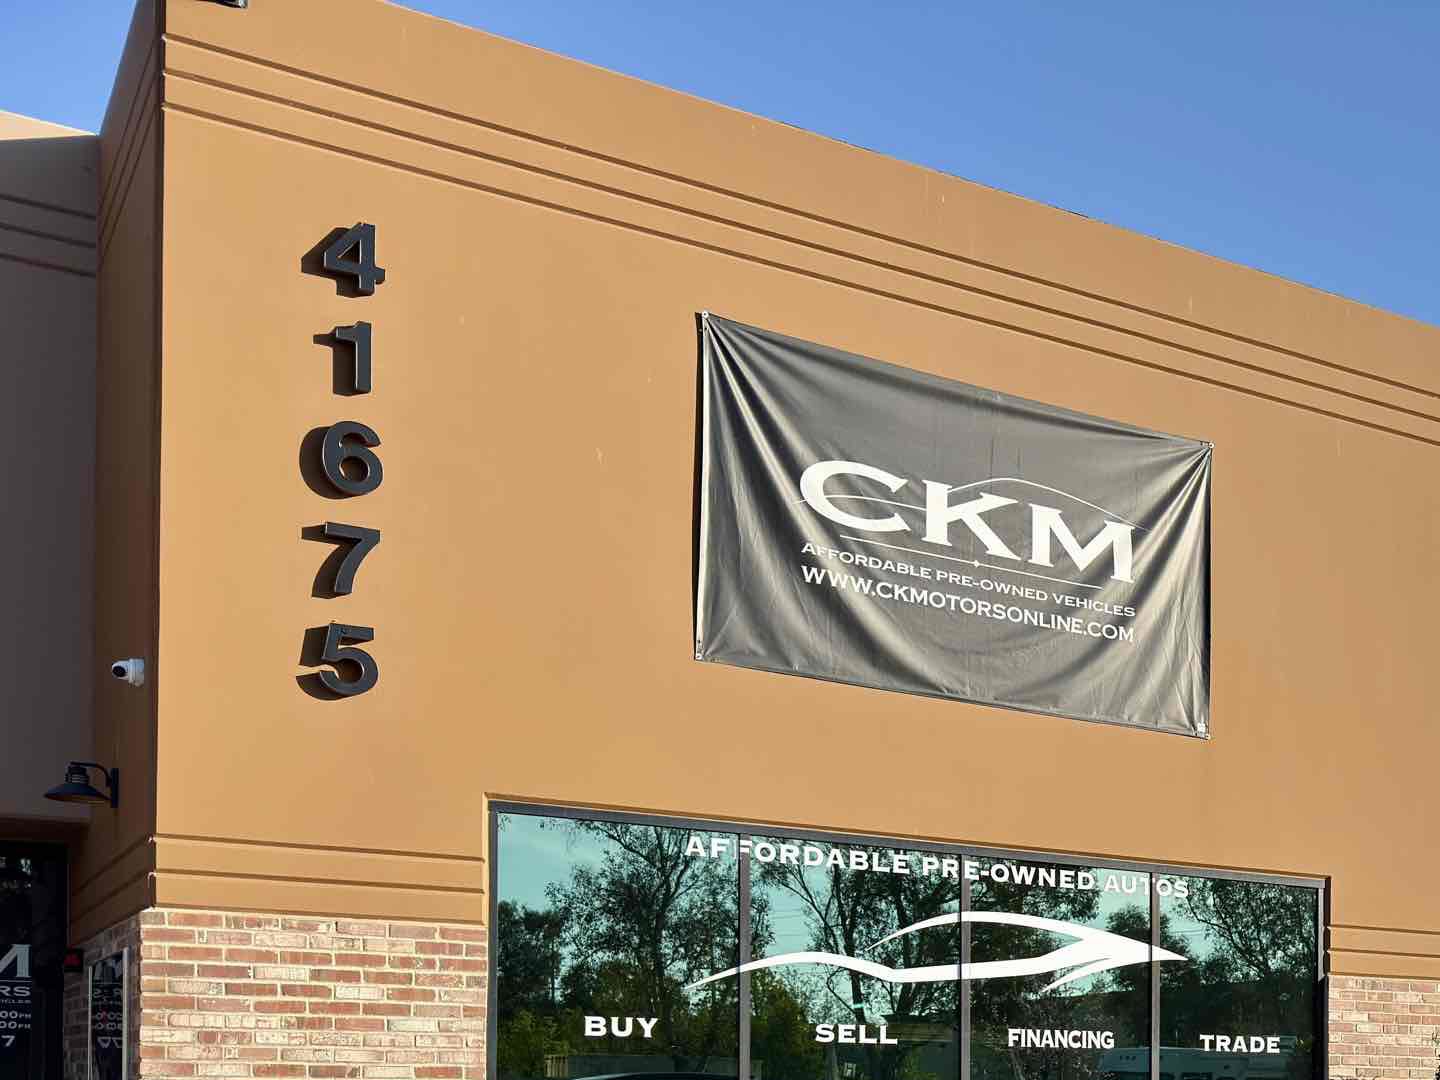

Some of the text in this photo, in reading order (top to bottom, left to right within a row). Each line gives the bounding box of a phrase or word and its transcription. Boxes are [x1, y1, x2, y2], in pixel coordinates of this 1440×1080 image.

[297, 221, 386, 701] 41675
[799, 459, 1136, 583] CKM
[801, 542, 1136, 618] AFFORDABLE PRE-OWNED VEHICLES
[801, 565, 1135, 642] WWW.CKMOTORSONLINE.COM
[685, 836, 1190, 898] AFFORDABLE PRE-OWNED AUTOS
[584, 1015, 658, 1039] BUY
[814, 1023, 898, 1045] SELL
[1007, 1027, 1115, 1049] FINANCING
[1199, 1034, 1281, 1053] TRADE
